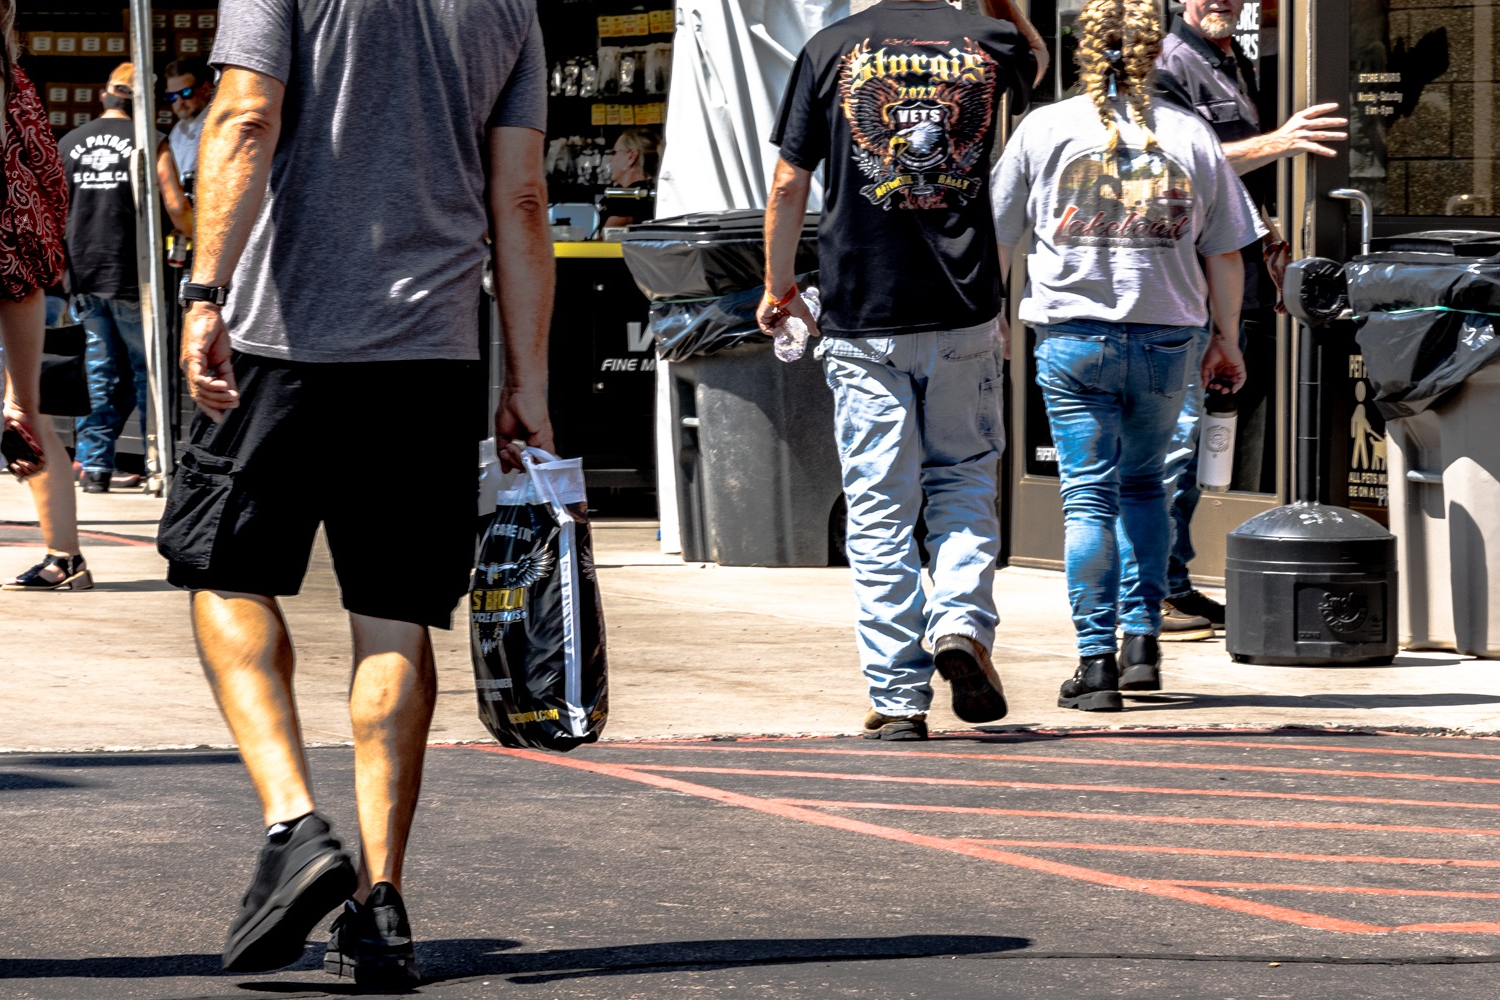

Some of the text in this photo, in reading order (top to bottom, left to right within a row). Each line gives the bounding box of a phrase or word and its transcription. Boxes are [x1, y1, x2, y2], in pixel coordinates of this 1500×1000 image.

[850, 46, 986, 94] Sturgis
[898, 86, 937, 99] 2022
[897, 109, 940, 123] VETS
[937, 174, 972, 190] RALLY
[601, 358, 638, 372] FINE
